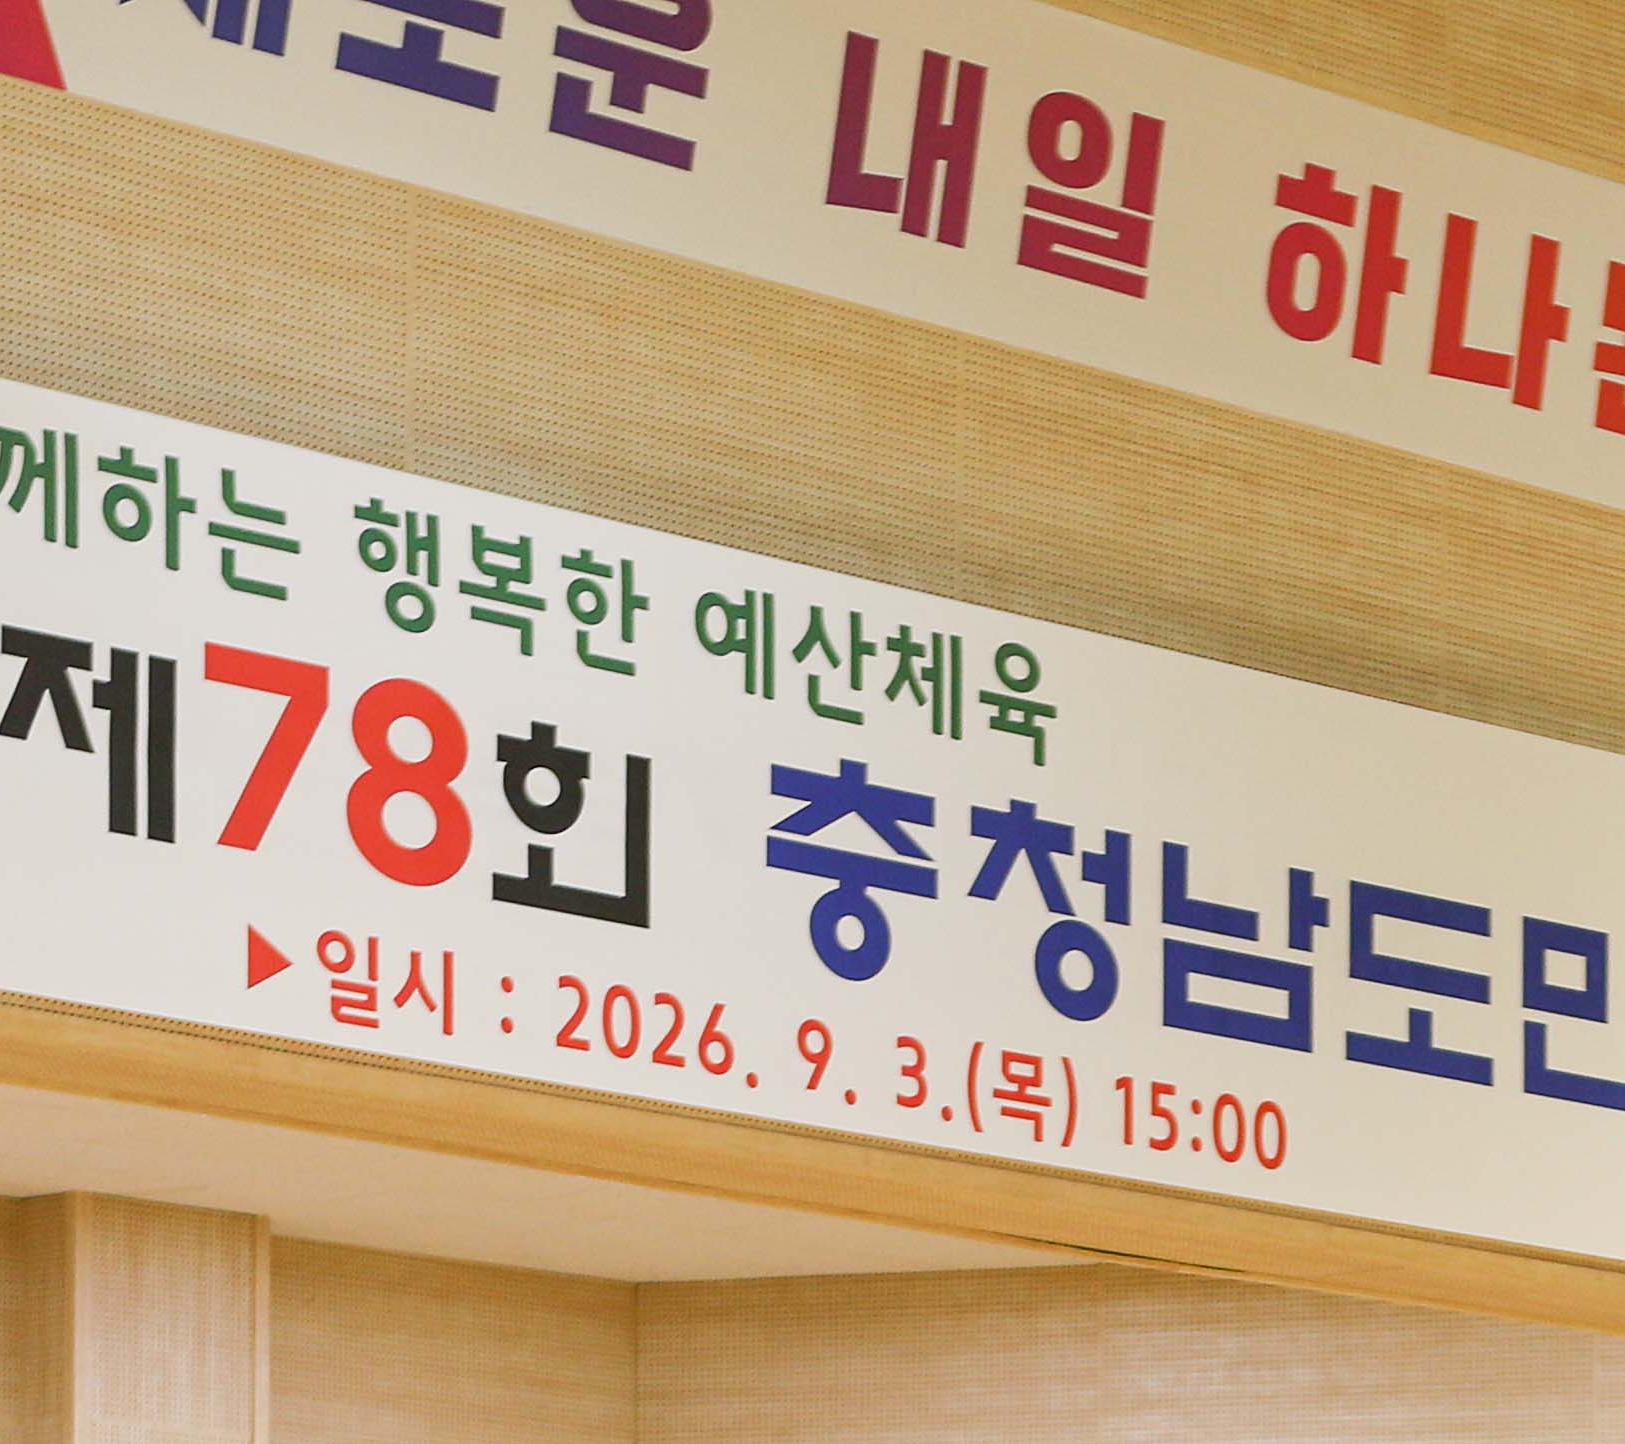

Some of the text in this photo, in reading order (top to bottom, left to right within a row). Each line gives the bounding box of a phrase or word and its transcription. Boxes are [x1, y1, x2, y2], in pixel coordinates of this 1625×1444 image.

[826, 31, 1165, 299] 내일
[353, 497, 650, 677] 행복한
[695, 588, 1058, 766] 예산체육
[316, 930, 455, 1036] 일시
[556, 974, 759, 1089] 2026.
[796, 1019, 856, 1106] 9.
[896, 1036, 1078, 1148] 3.(목)
[1113, 1074, 1288, 1171] 15:00
